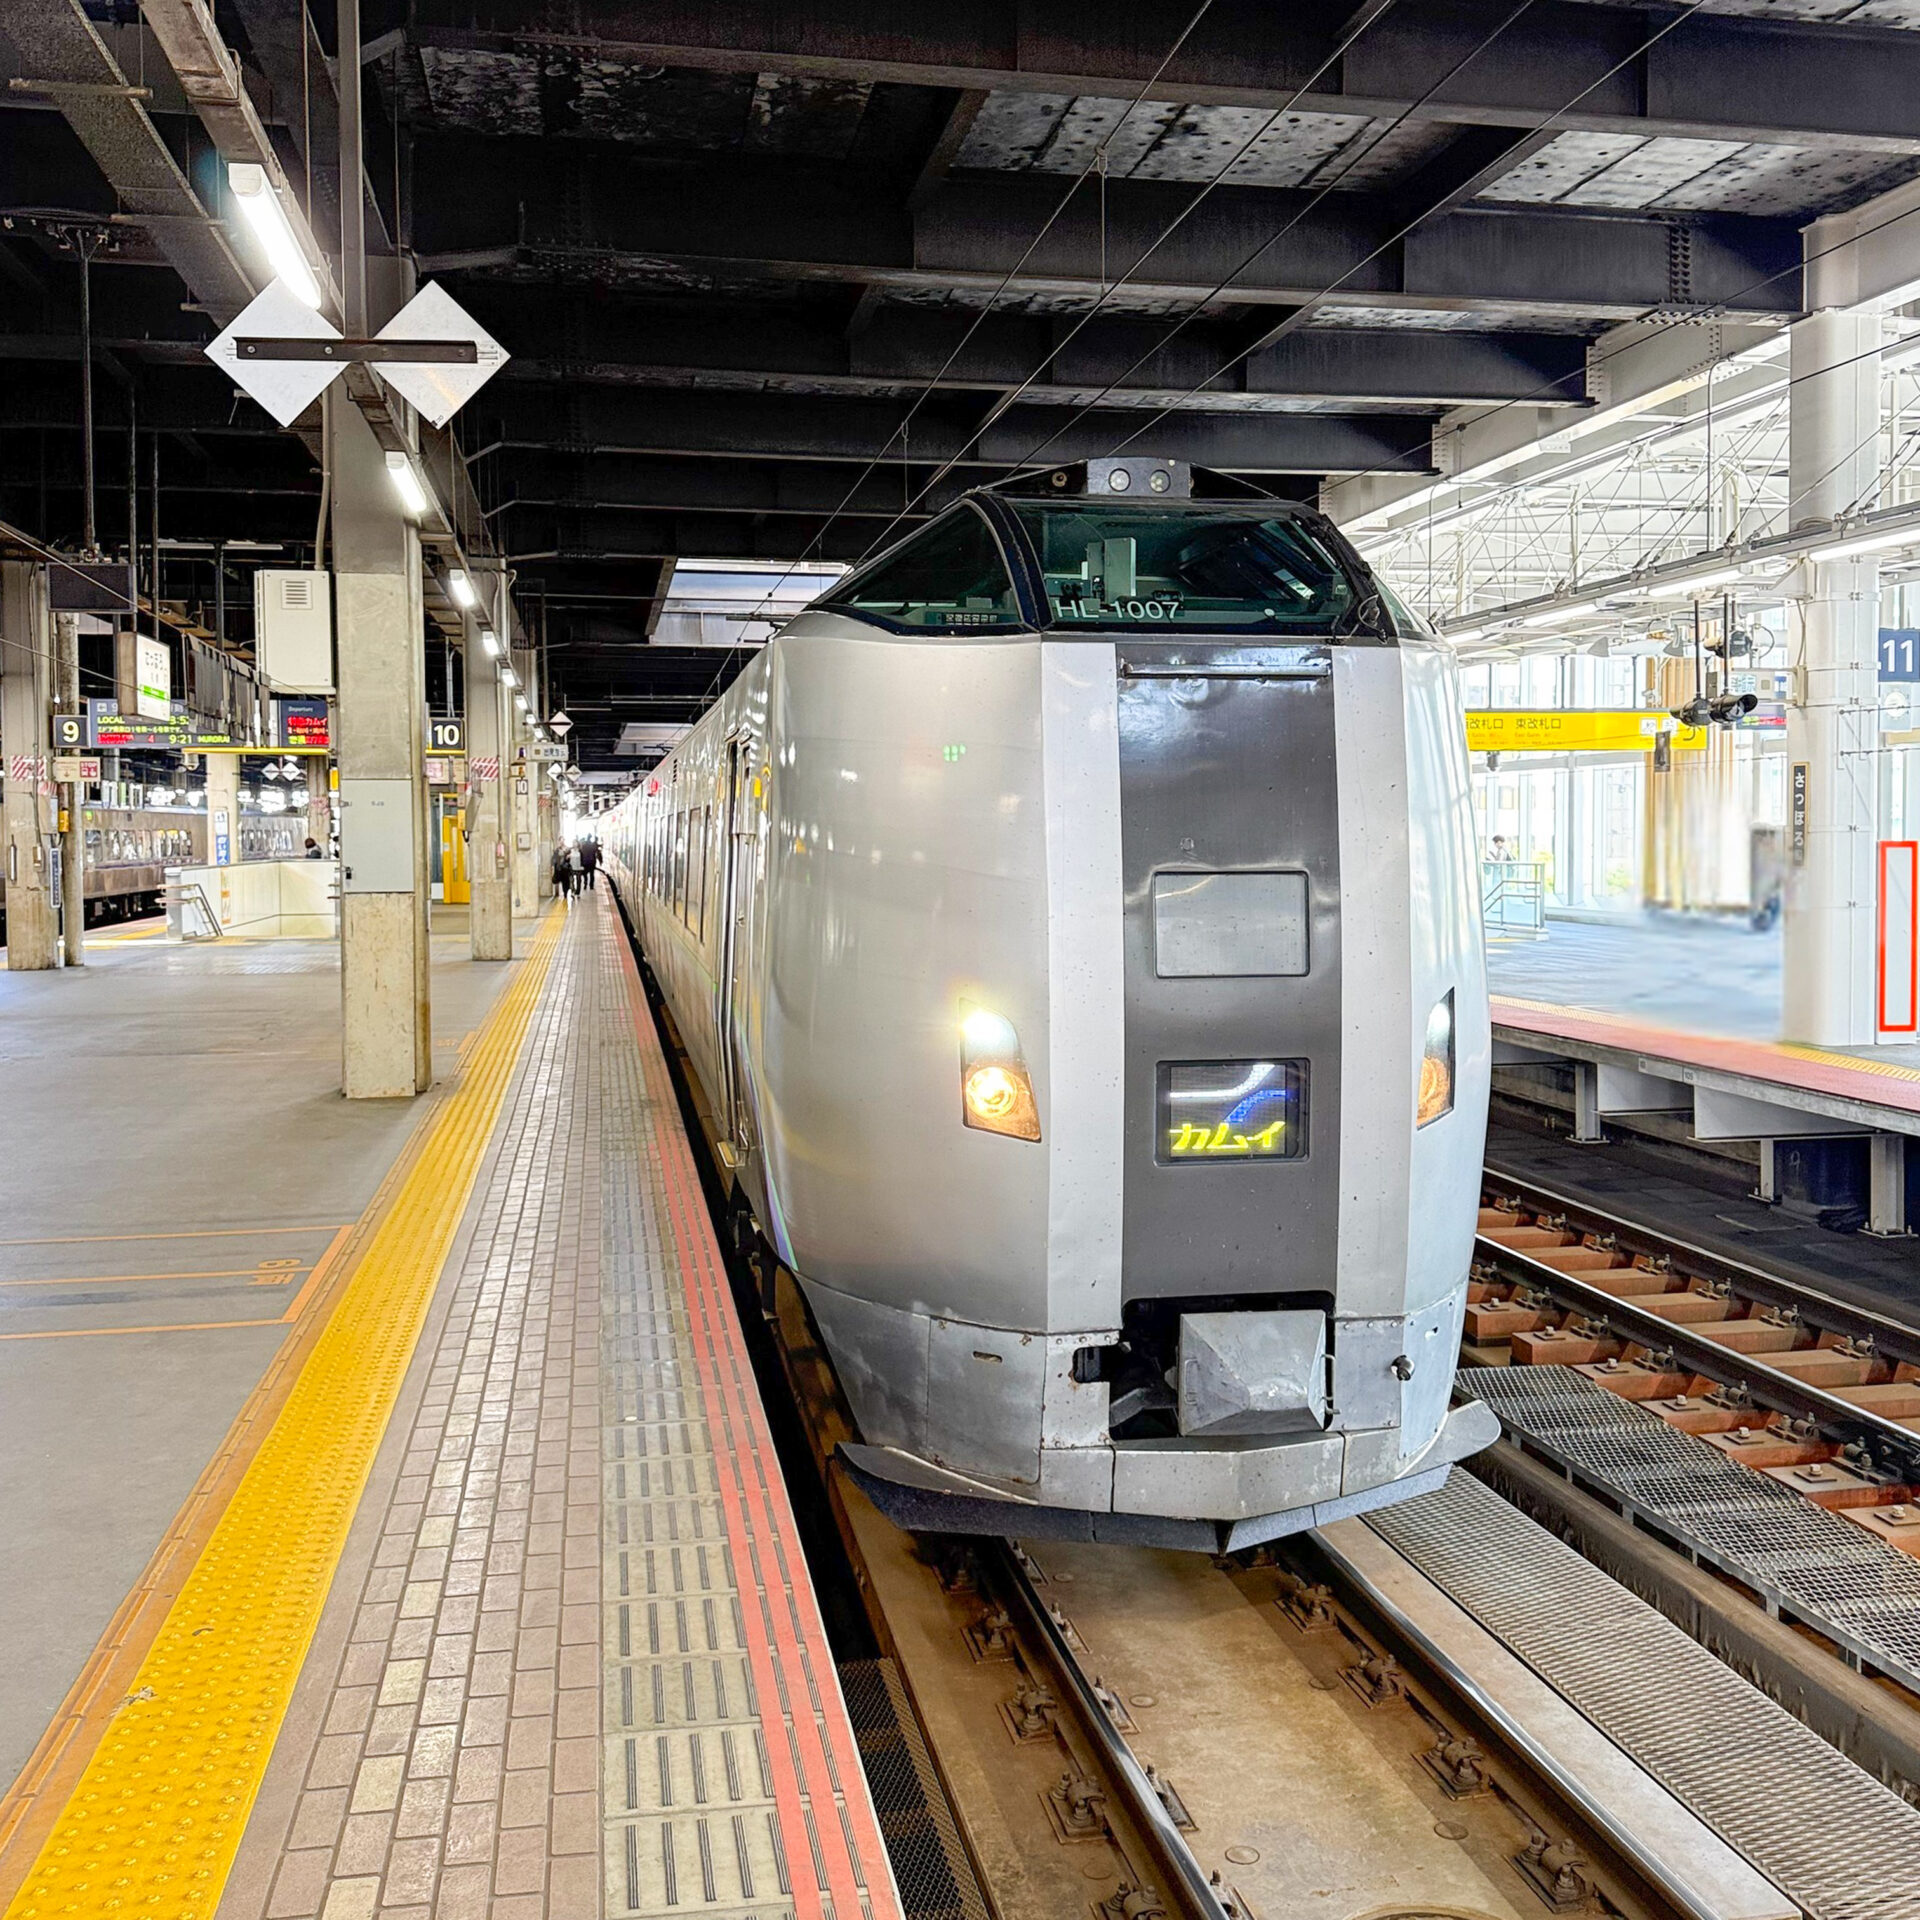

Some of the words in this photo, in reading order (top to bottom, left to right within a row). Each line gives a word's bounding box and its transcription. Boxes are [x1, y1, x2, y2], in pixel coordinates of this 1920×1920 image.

[1055, 600, 1179, 619] HL-1007
[1883, 639, 1913, 673] 11
[97, 716, 125, 724] LOCAL
[1466, 718, 1503, 729] 改札口
[1516, 718, 1561, 730] 東改札口
[62, 721, 80, 743] 9
[168, 734, 193, 745] 9:21
[434, 725, 460, 746] 10
[1169, 1121, 1286, 1151] カムイ
